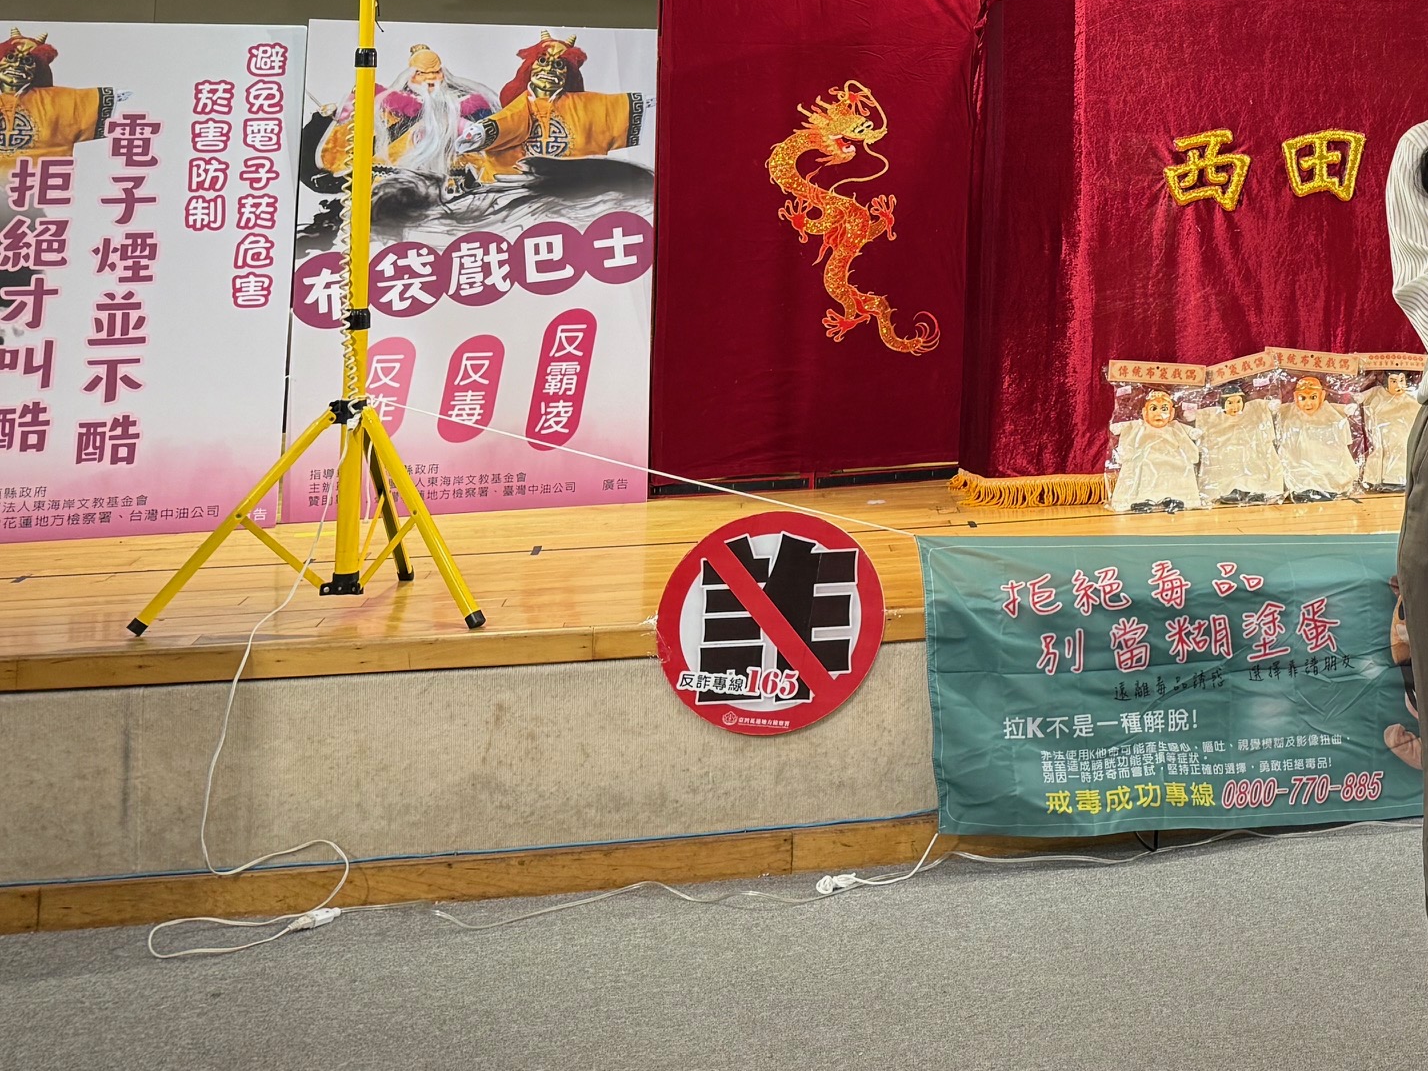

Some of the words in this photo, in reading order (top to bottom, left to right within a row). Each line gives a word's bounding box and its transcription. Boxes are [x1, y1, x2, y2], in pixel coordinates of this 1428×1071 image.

[186, 80, 234, 231] 菸害防制
[231, 42, 289, 308] 避免電子菸危害
[1164, 129, 1366, 211] 西田
[0, 159, 75, 453] 拒絕才叫酷
[75, 113, 161, 464] 電子煙並不酷
[304, 227, 644, 323] 布袋戲巴士
[447, 352, 494, 425] 反毒
[534, 324, 587, 435] 反霸凌
[1207, 356, 1266, 379] 布袋戲偶
[0, 486, 47, 499] 縣政府
[0, 494, 148, 513] 法人東海岸文教基金會
[0, 504, 220, 529] 花蓮地方檢察署、台灣中油公司
[249, 507, 268, 522] 告
[602, 479, 629, 492] 廣告
[1001, 560, 1264, 618] 拒絕毒品
[1037, 597, 1341, 676] 別當糊塗蛋
[1045, 782, 1216, 815] 戒毒成功專線
[1221, 770, 1384, 810] 0800-770-885
